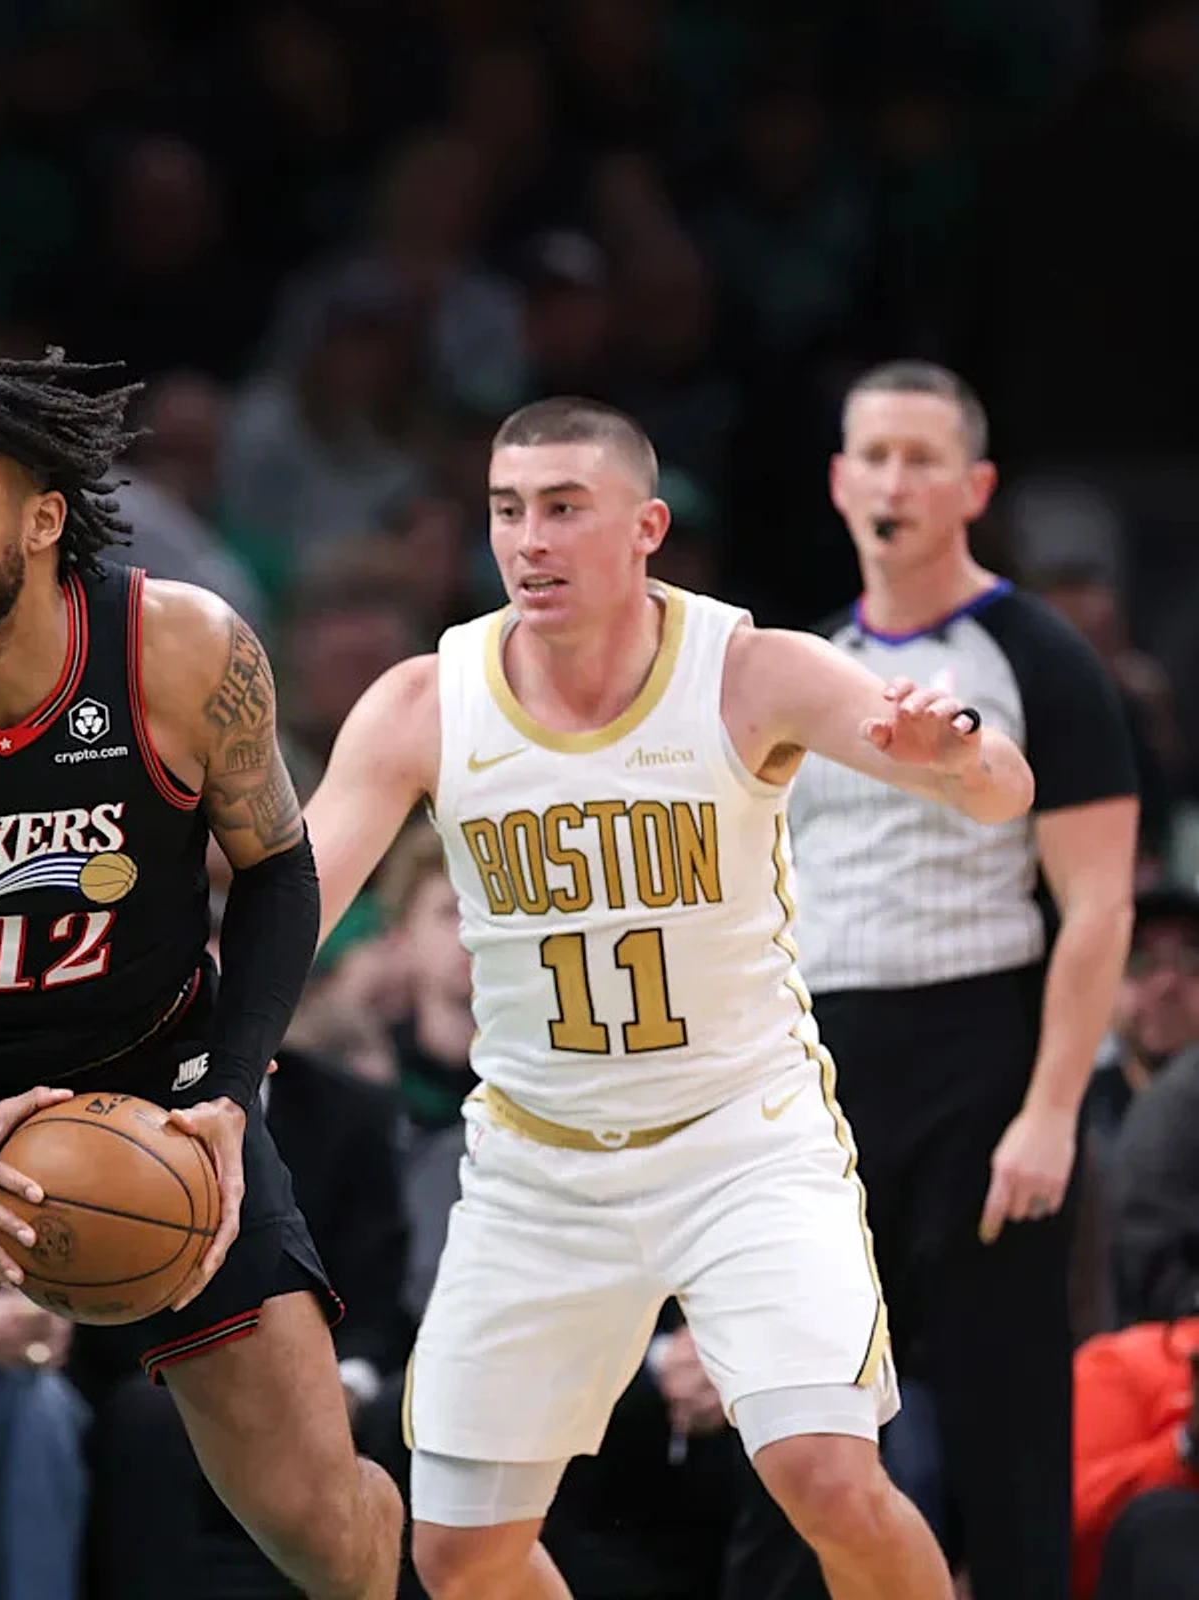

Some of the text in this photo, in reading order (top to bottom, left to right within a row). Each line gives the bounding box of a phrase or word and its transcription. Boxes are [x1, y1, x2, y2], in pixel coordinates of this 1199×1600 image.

[54, 746, 128, 764] crypto.com
[624, 745, 696, 769] Amica
[460, 800, 722, 914] BOSTON
[540, 928, 688, 1055] 11
[178, 1052, 210, 1084] NIKE
